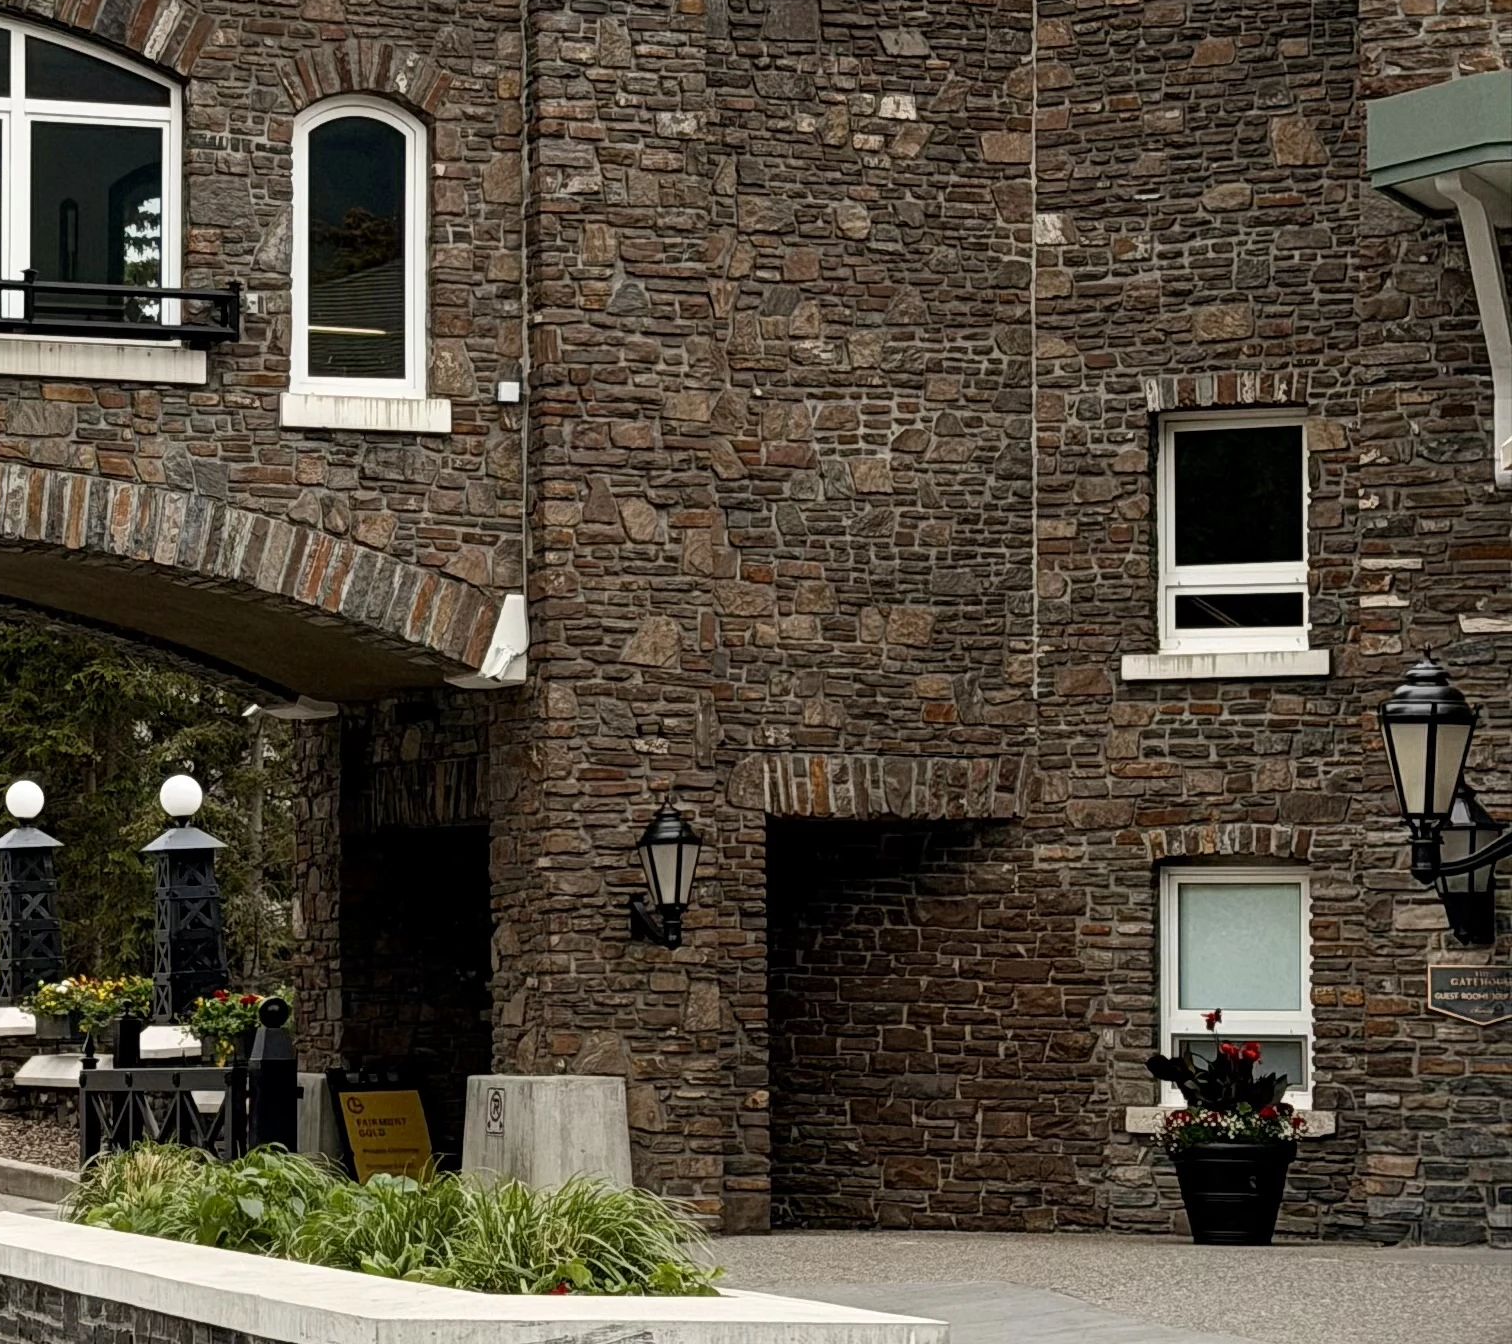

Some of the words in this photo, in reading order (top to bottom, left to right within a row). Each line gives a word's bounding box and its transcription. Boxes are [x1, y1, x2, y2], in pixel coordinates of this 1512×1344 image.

[1434, 991, 1459, 1000] GUEST
[356, 1118, 407, 1127] FAIRMONT
[358, 1128, 386, 1137] GOLD
